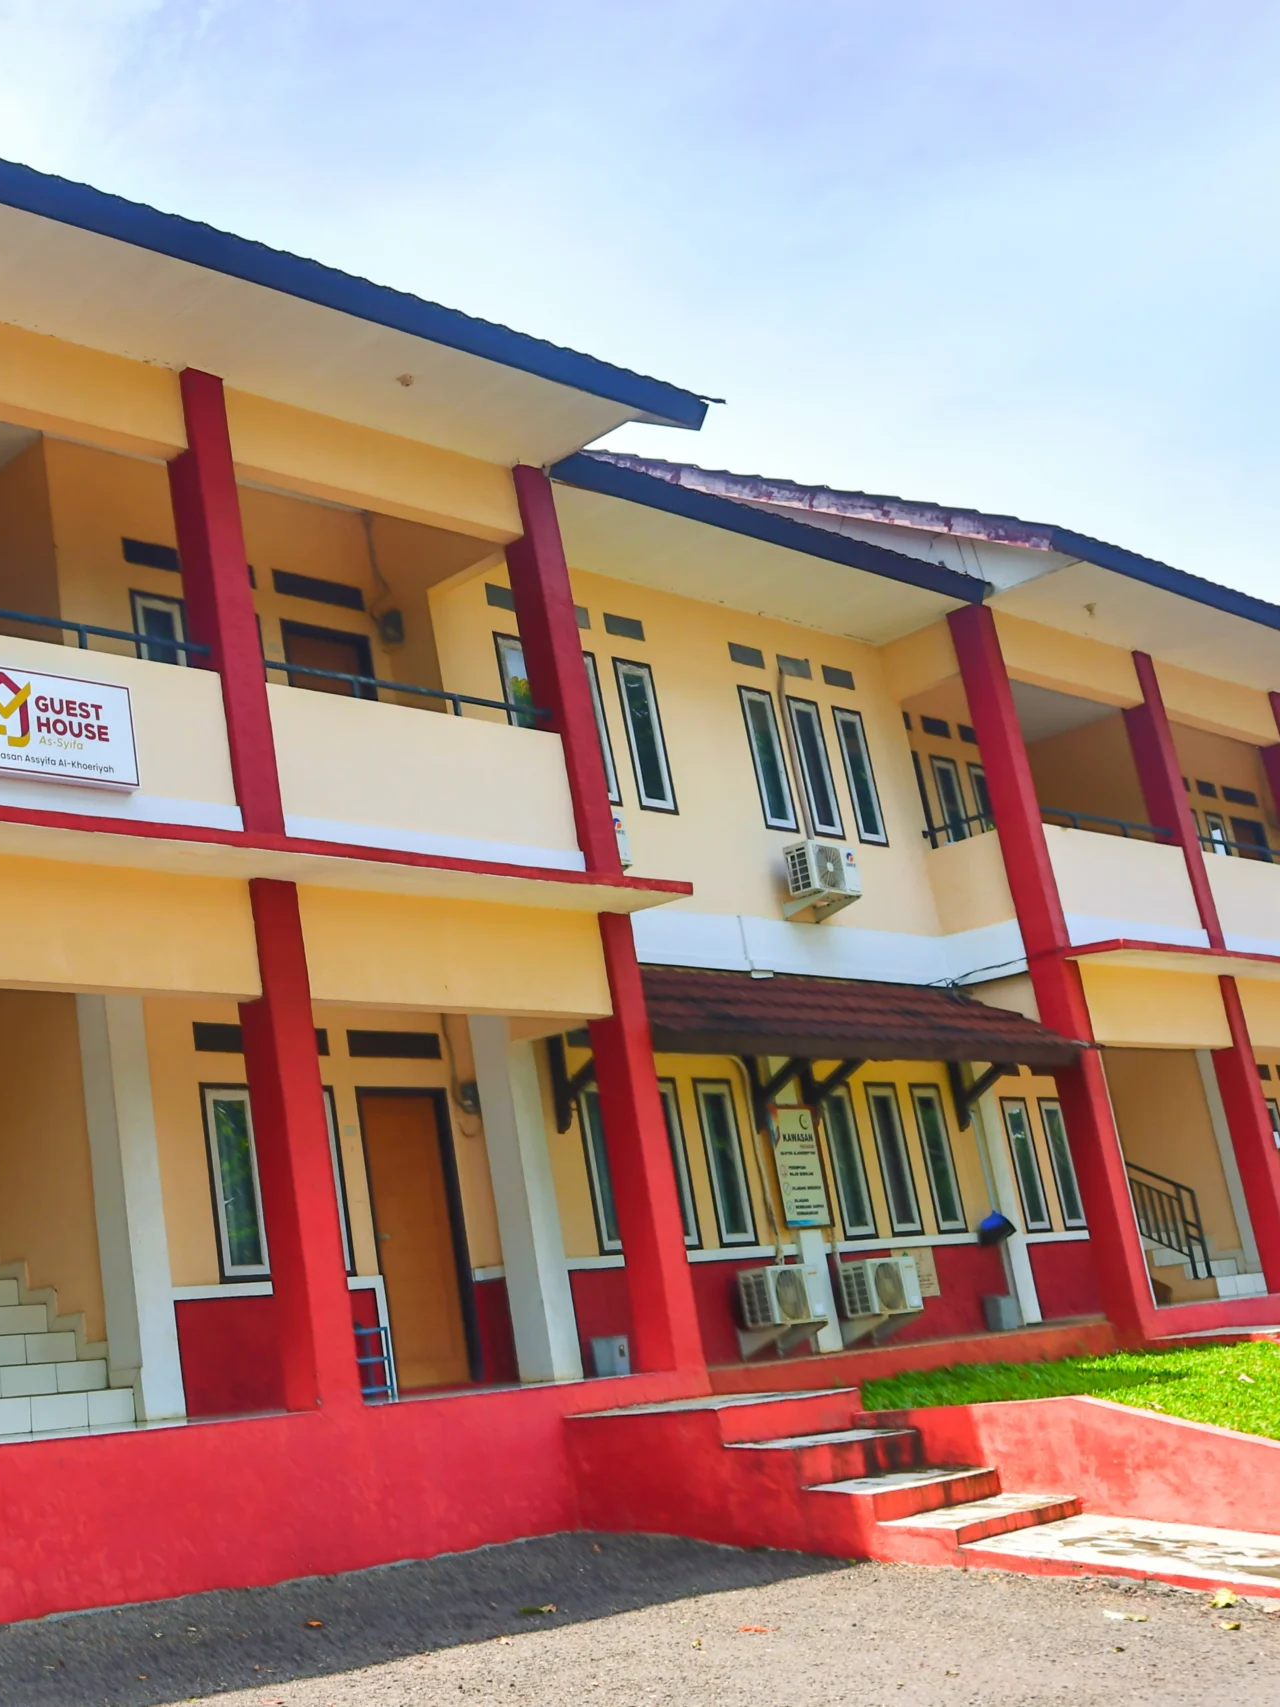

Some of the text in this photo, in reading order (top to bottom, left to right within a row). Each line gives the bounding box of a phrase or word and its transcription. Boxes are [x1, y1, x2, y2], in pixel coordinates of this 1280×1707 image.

[34, 695, 103, 721] GUEST
[36, 716, 110, 742] HOUSE
[39, 735, 84, 750] As-Syifa
[24, 754, 57, 767] Assyifa
[58, 759, 115, 774] Al-Khoeriyah
[782, 1133, 814, 1142] KAWASAN
